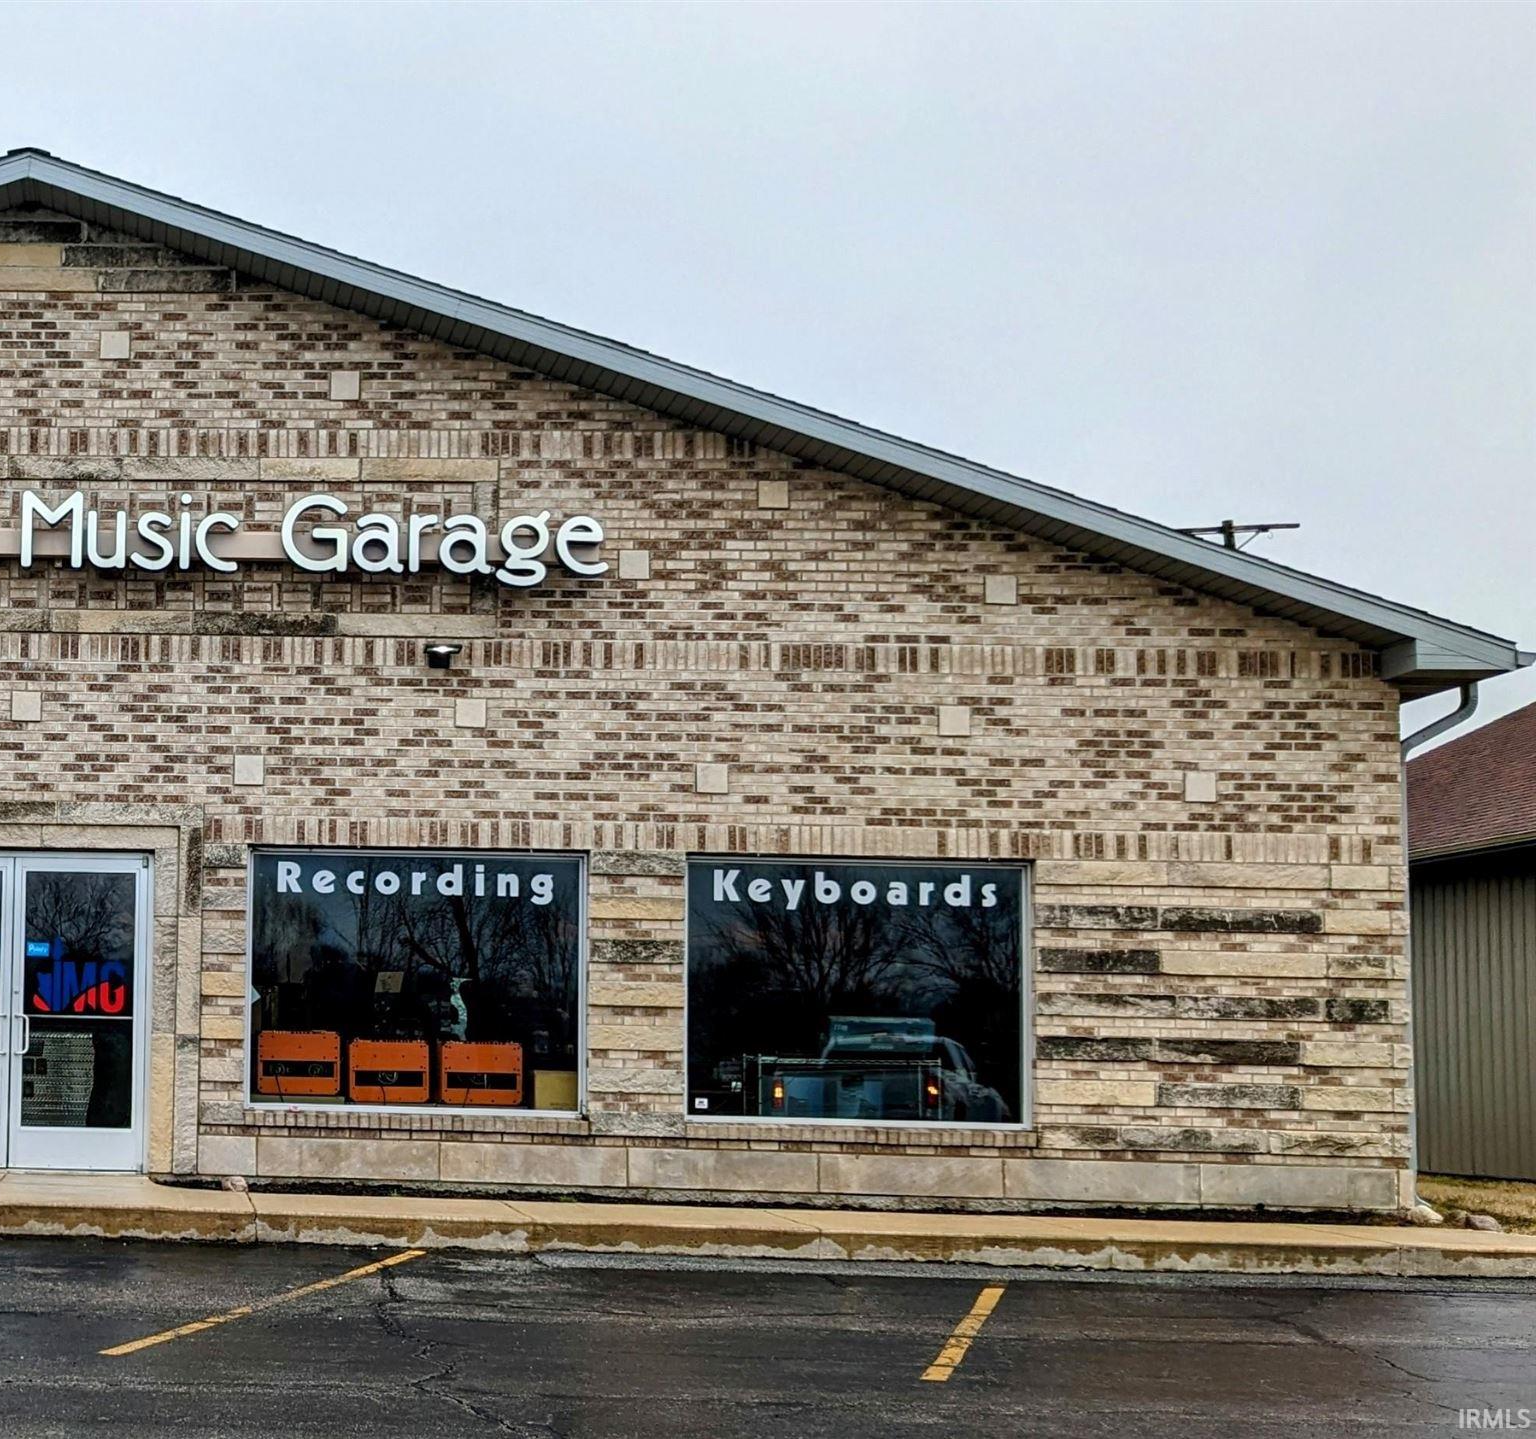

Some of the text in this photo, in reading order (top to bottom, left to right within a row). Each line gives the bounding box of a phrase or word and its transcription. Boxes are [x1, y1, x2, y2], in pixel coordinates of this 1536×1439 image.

[20, 489, 239, 571] Music
[281, 494, 610, 587] Garage
[276, 860, 555, 906] Recording
[713, 868, 998, 911] Keyboards
